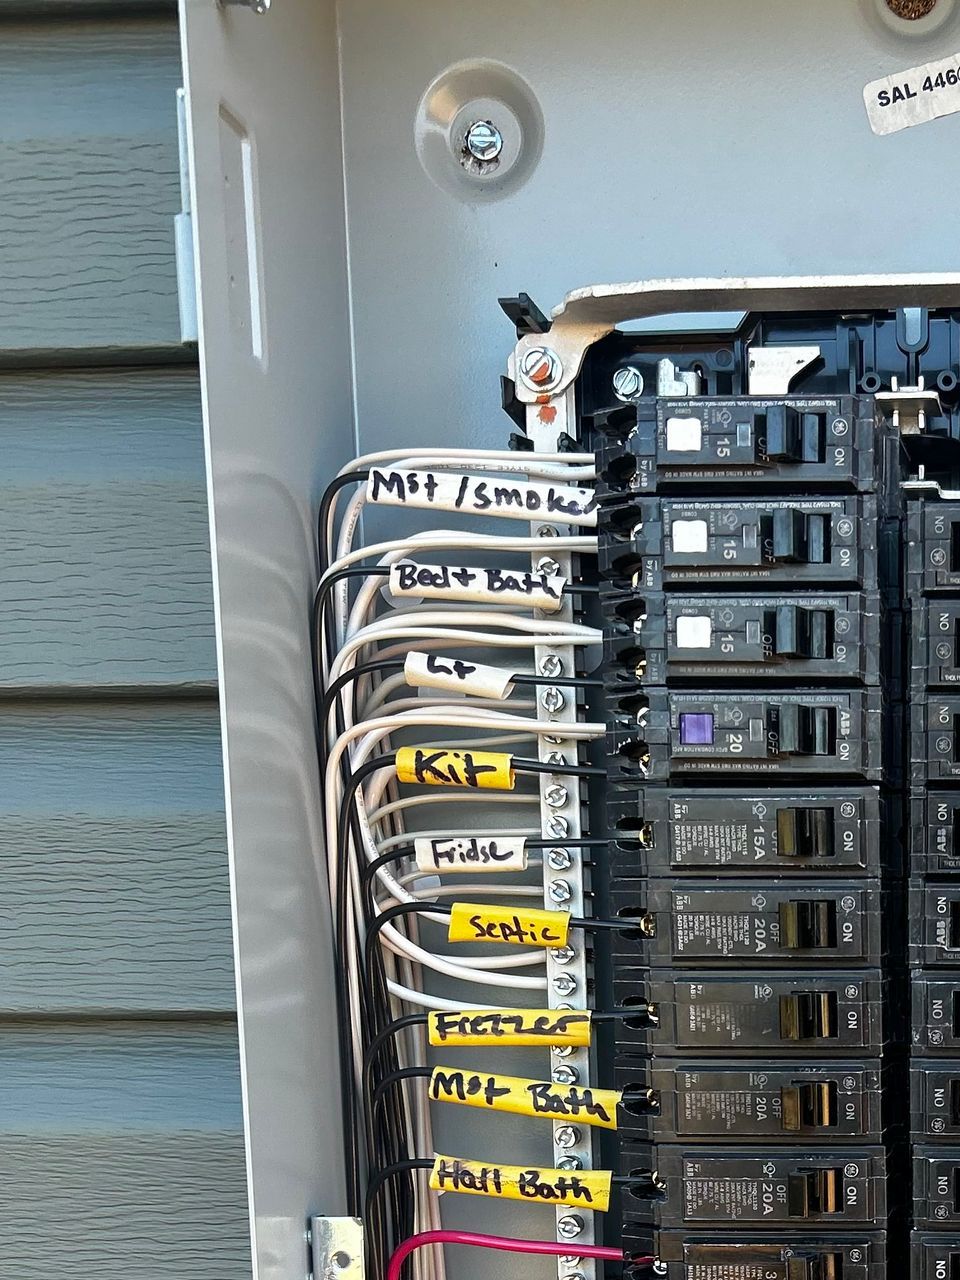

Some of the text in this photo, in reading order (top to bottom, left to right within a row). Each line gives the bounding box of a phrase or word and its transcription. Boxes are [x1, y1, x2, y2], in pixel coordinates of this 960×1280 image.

[878, 83, 917, 107] SAL
[716, 437, 730, 457] 15
[642, 460, 648, 470] by
[834, 448, 844, 466] ON
[935, 516, 944, 533] ON
[723, 540, 736, 559] 15
[840, 550, 850, 567] ON
[486, 569, 559, 599] Bath
[939, 613, 950, 631] ON
[720, 634, 734, 653] 15
[763, 634, 772, 656] OFF
[836, 645, 846, 663] ON
[840, 711, 850, 736] ABB
[939, 706, 949, 724] ON
[729, 734, 742, 753] 20
[768, 732, 778, 755] OFF
[840, 744, 849, 761] ON
[415, 750, 497, 786] Kit
[938, 804, 948, 821] ON
[754, 826, 766, 860] 15A
[844, 832, 853, 851] ON
[937, 828, 946, 852] ABB
[938, 897, 947, 914] ON
[470, 916, 560, 942] Septic
[755, 919, 766, 952] 20A
[770, 923, 779, 942] OFF
[842, 923, 852, 942] ON
[936, 921, 946, 945] ABB
[933, 1000, 943, 1019] ON
[847, 1012, 857, 1029] ON
[528, 1084, 610, 1122] Bath
[935, 1088, 944, 1107] ON
[756, 1098, 767, 1120] 20A
[772, 1098, 781, 1118] OFF
[846, 1103, 855, 1120] ON
[438, 1160, 593, 1202] Hall Bath
[938, 1177, 948, 1195] ON
[763, 1183, 773, 1215] 20A
[777, 1185, 786, 1203] OFF
[847, 1187, 856, 1205] ON
[936, 1260, 946, 1279] ON
